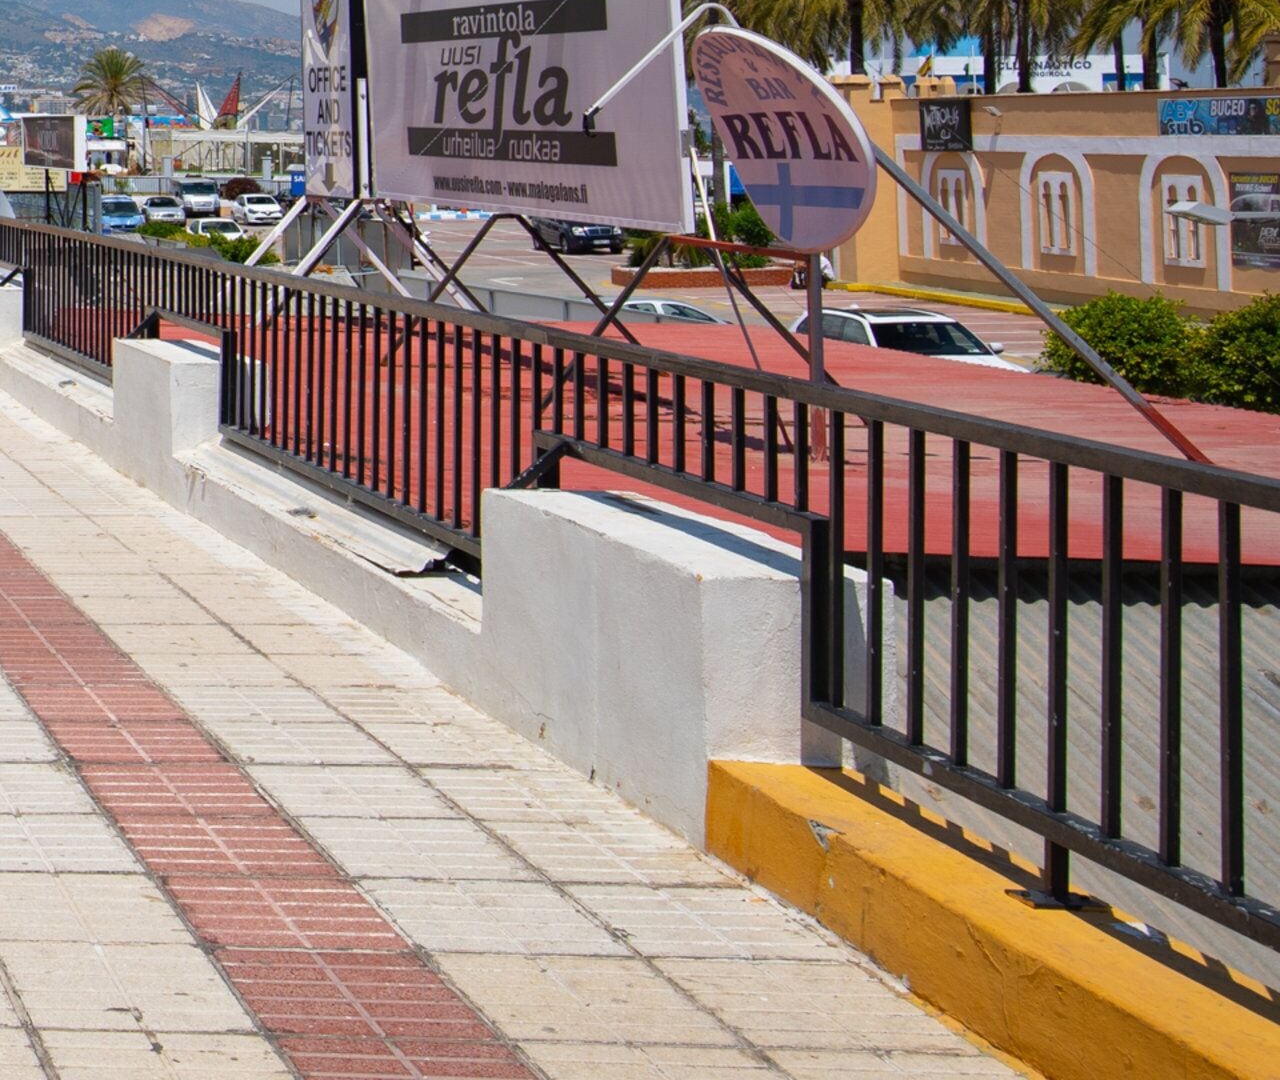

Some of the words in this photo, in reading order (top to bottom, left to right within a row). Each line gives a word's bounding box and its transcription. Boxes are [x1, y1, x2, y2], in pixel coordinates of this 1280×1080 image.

[452, 4, 536, 36] ravintola
[440, 45, 481, 67] UUSI
[308, 66, 346, 93] OFFICE
[434, 30, 573, 150] refla
[745, 77, 796, 100] BAR
[317, 99, 340, 124] AND
[1209, 99, 1245, 117] BUCEO
[721, 111, 860, 163] REFLA
[1168, 120, 1205, 135] sub
[306, 131, 352, 158] TICKETS
[443, 130, 495, 158] urheilua
[508, 134, 561, 161] ruokaa
